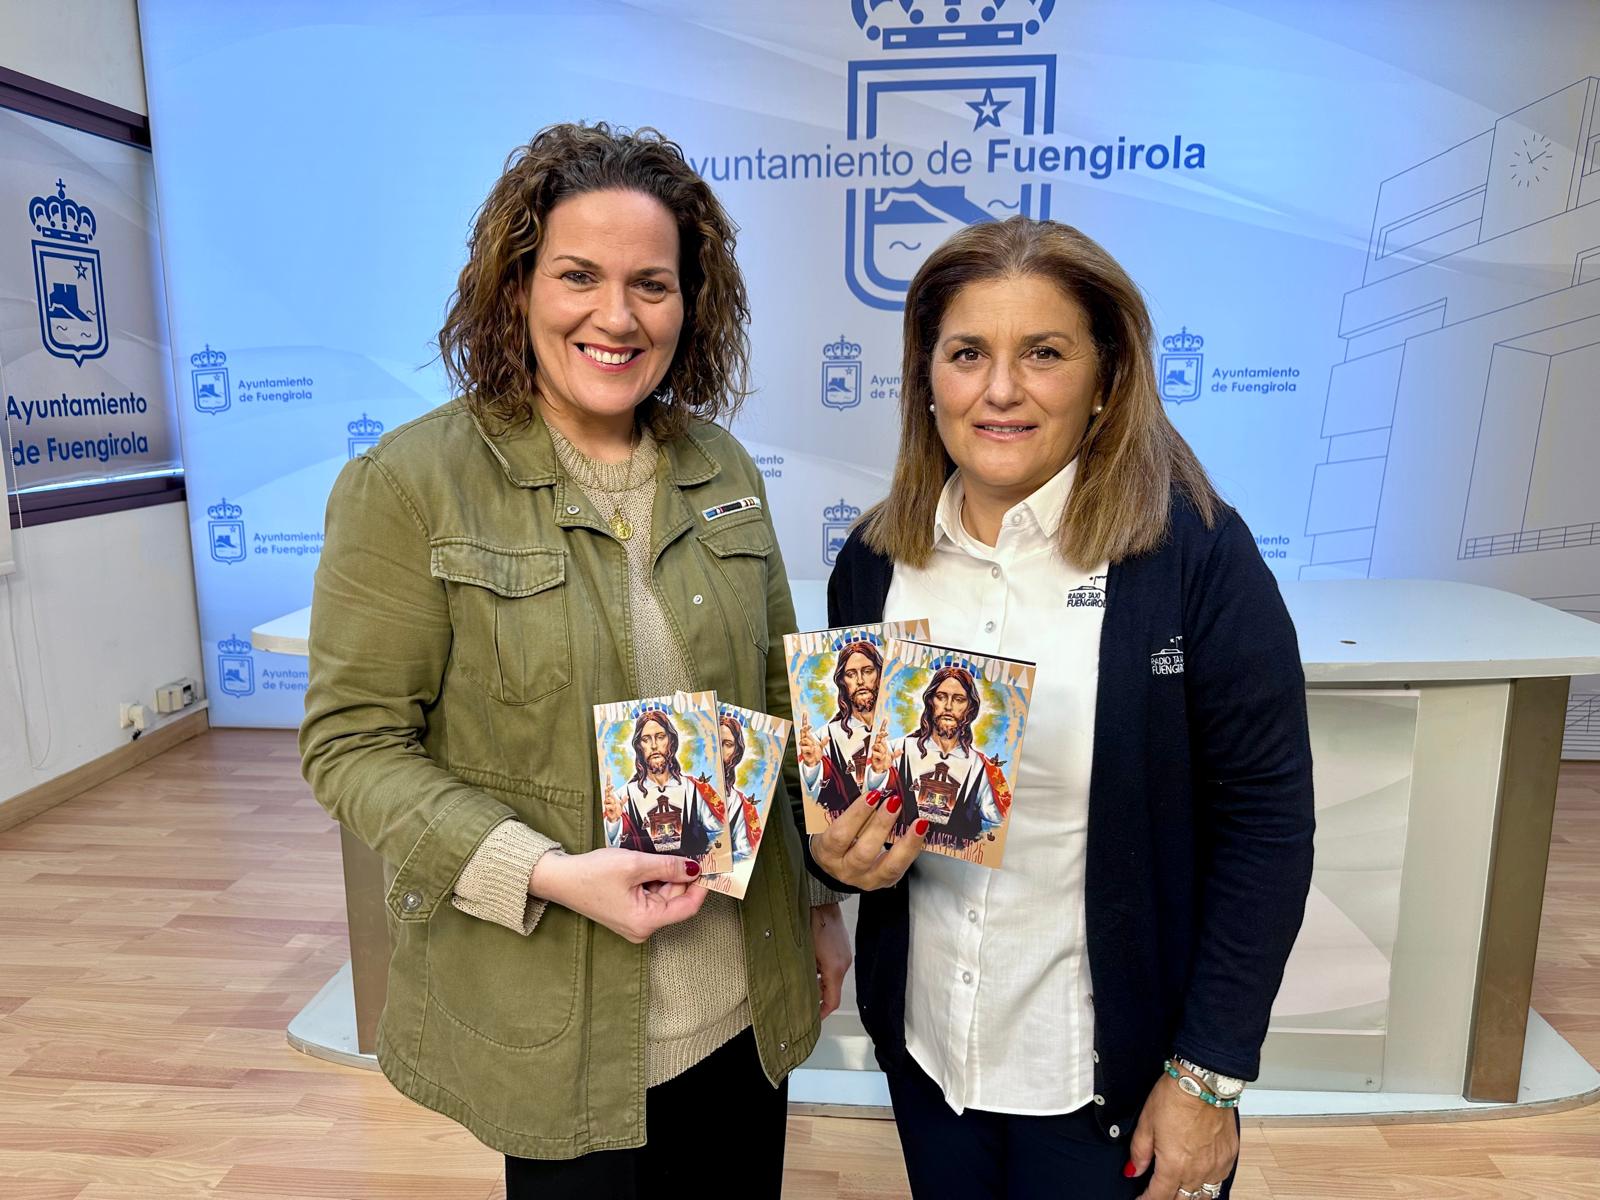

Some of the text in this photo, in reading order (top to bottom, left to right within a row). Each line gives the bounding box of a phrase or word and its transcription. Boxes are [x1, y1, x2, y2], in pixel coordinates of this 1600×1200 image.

[690, 135, 1206, 182] yuntamiento de Fuengirola
[1211, 367, 1300, 381] Ayuntamiento
[238, 376, 313, 390] Ayuntamiento
[1211, 380, 1297, 394] de Fuengirola
[239, 389, 313, 402] de Fuengirola
[870, 388, 886, 399] de
[5, 392, 147, 425] Ayuntamiento
[12, 431, 148, 466] de Fuengirola
[254, 544, 269, 554] de
[1066, 598, 1107, 608] FUENGIROL
[1151, 656, 1171, 665] RADIO
[262, 669, 309, 680] Ayuntam
[262, 680, 277, 690] de
